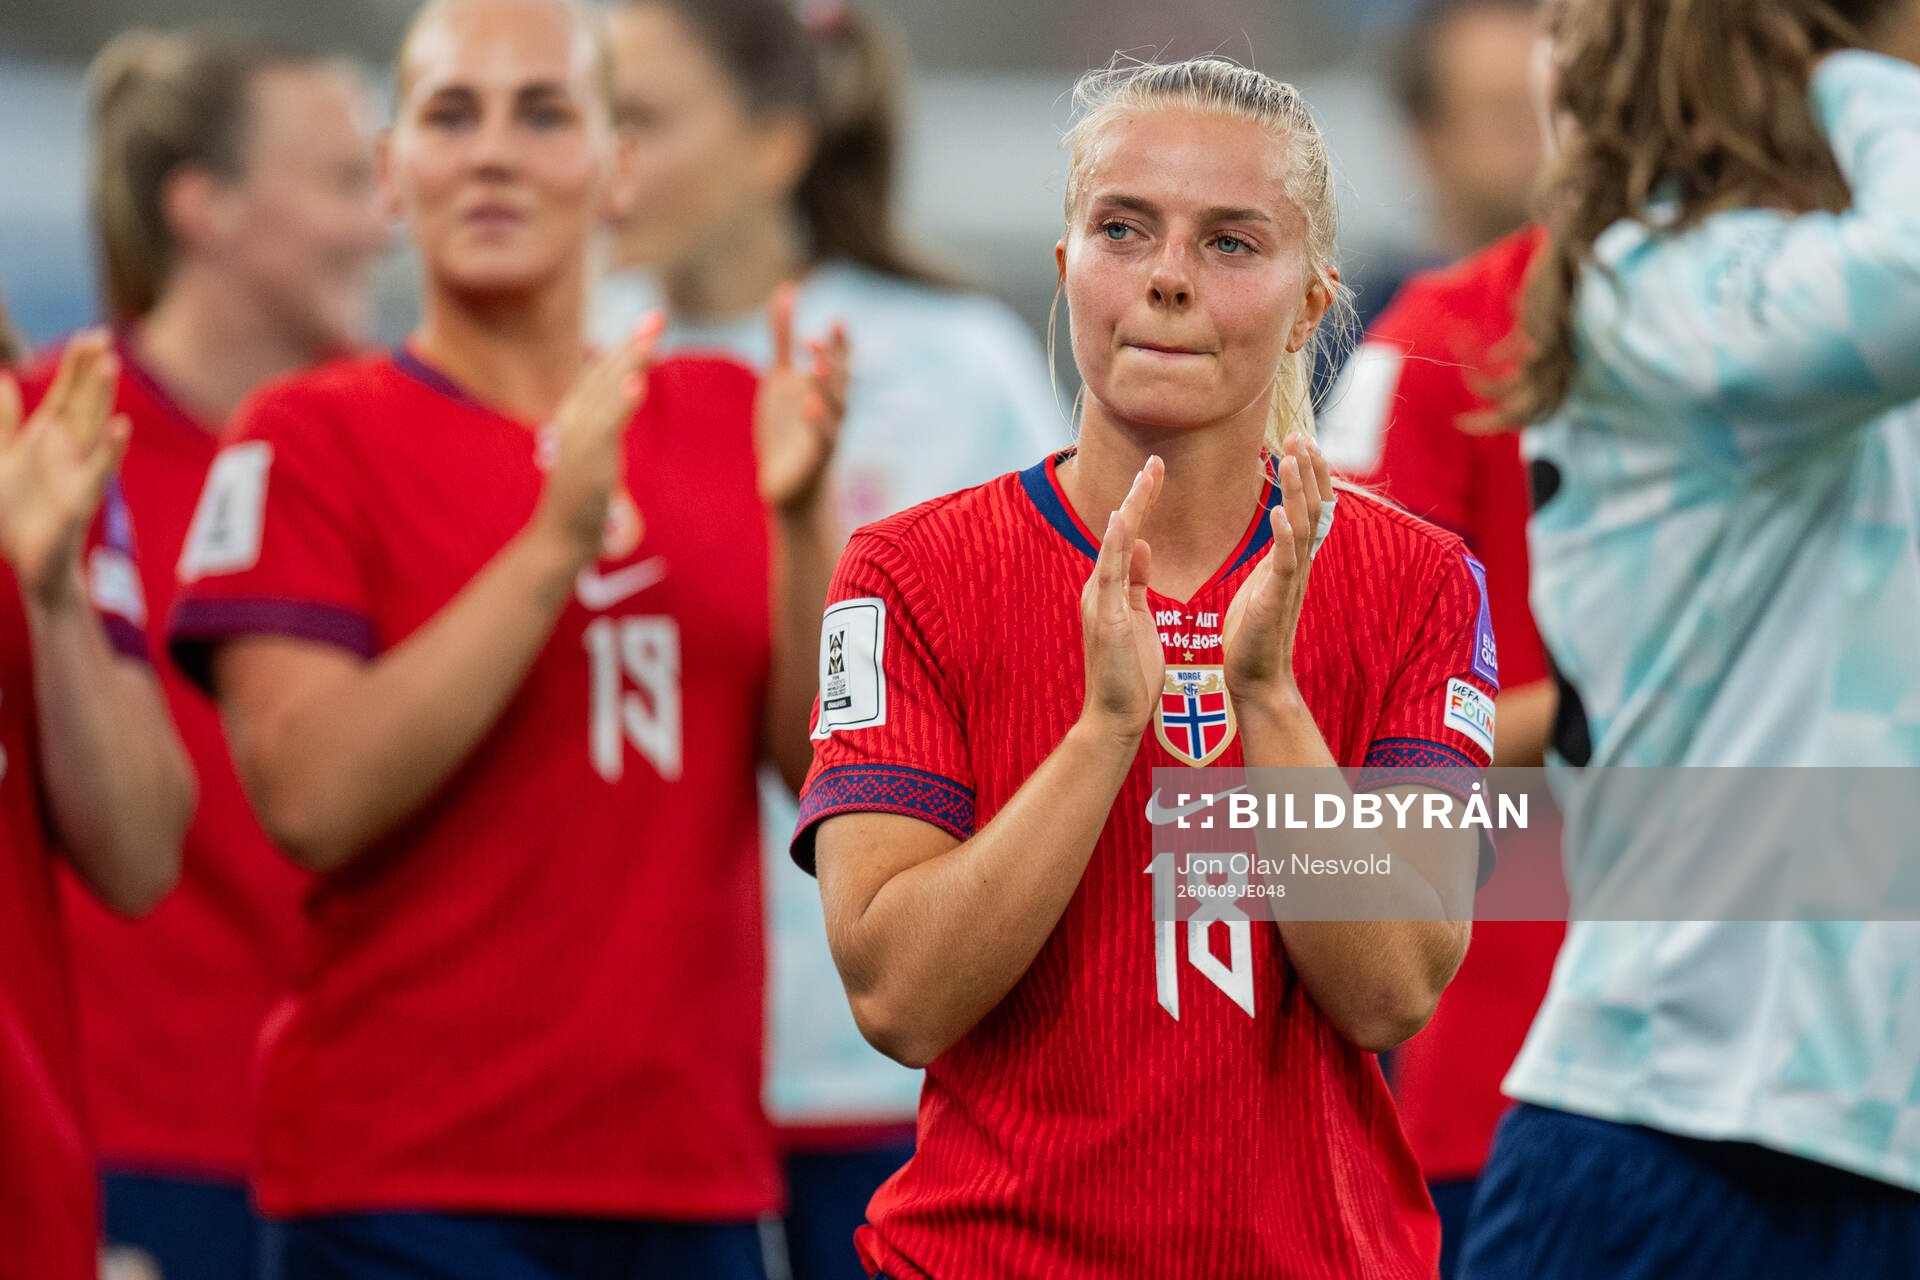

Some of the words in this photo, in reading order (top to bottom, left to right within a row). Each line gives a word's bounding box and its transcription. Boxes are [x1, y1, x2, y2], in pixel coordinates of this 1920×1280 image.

[1156, 610, 1182, 626] NOR
[1195, 612, 1219, 628] AUT
[1177, 672, 1202, 681] NORGE
[581, 614, 683, 783] 19
[1452, 683, 1480, 703] UEFA
[1143, 852, 1255, 1021] 18
